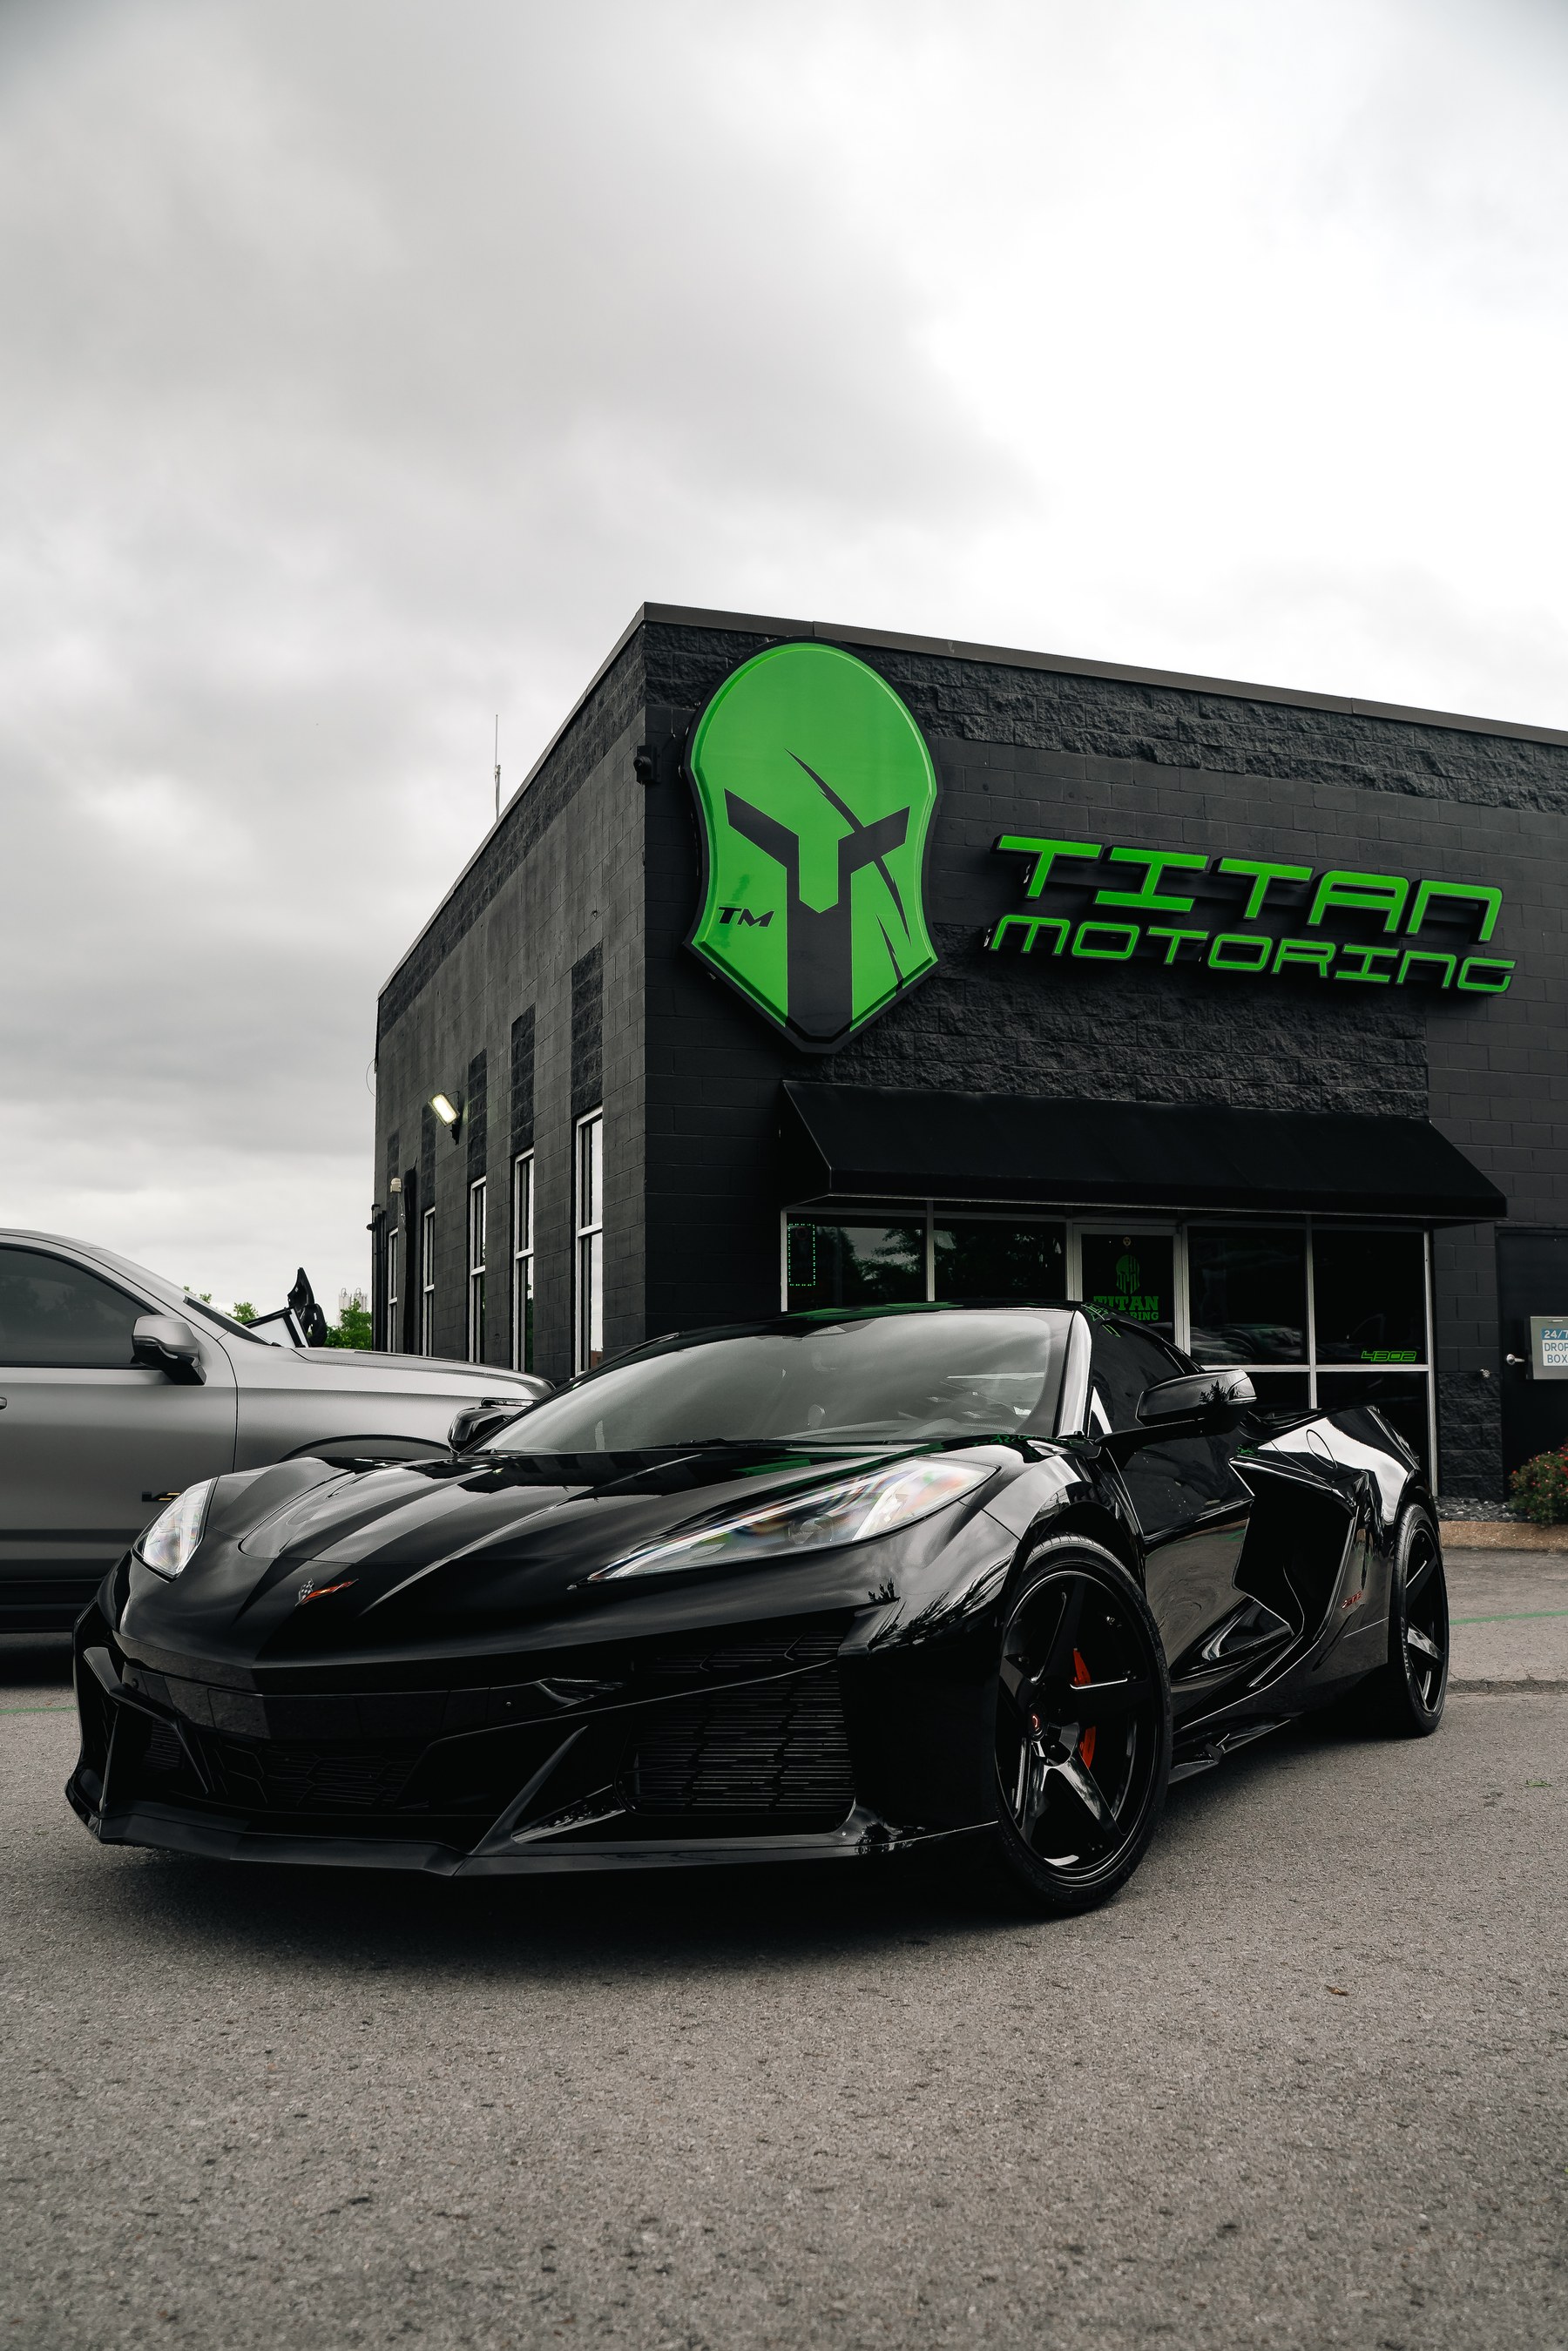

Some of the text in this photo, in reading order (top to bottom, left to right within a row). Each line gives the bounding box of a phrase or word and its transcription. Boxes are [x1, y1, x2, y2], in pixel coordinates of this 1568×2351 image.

[996, 834, 1504, 942] TITAN
[717, 906, 774, 928] TM
[989, 913, 1517, 993] MOTORING
[1129, 1311, 1159, 1321] RING
[1361, 1350, 1417, 1361] 4302
[1547, 1354, 1568, 1364] BOX
